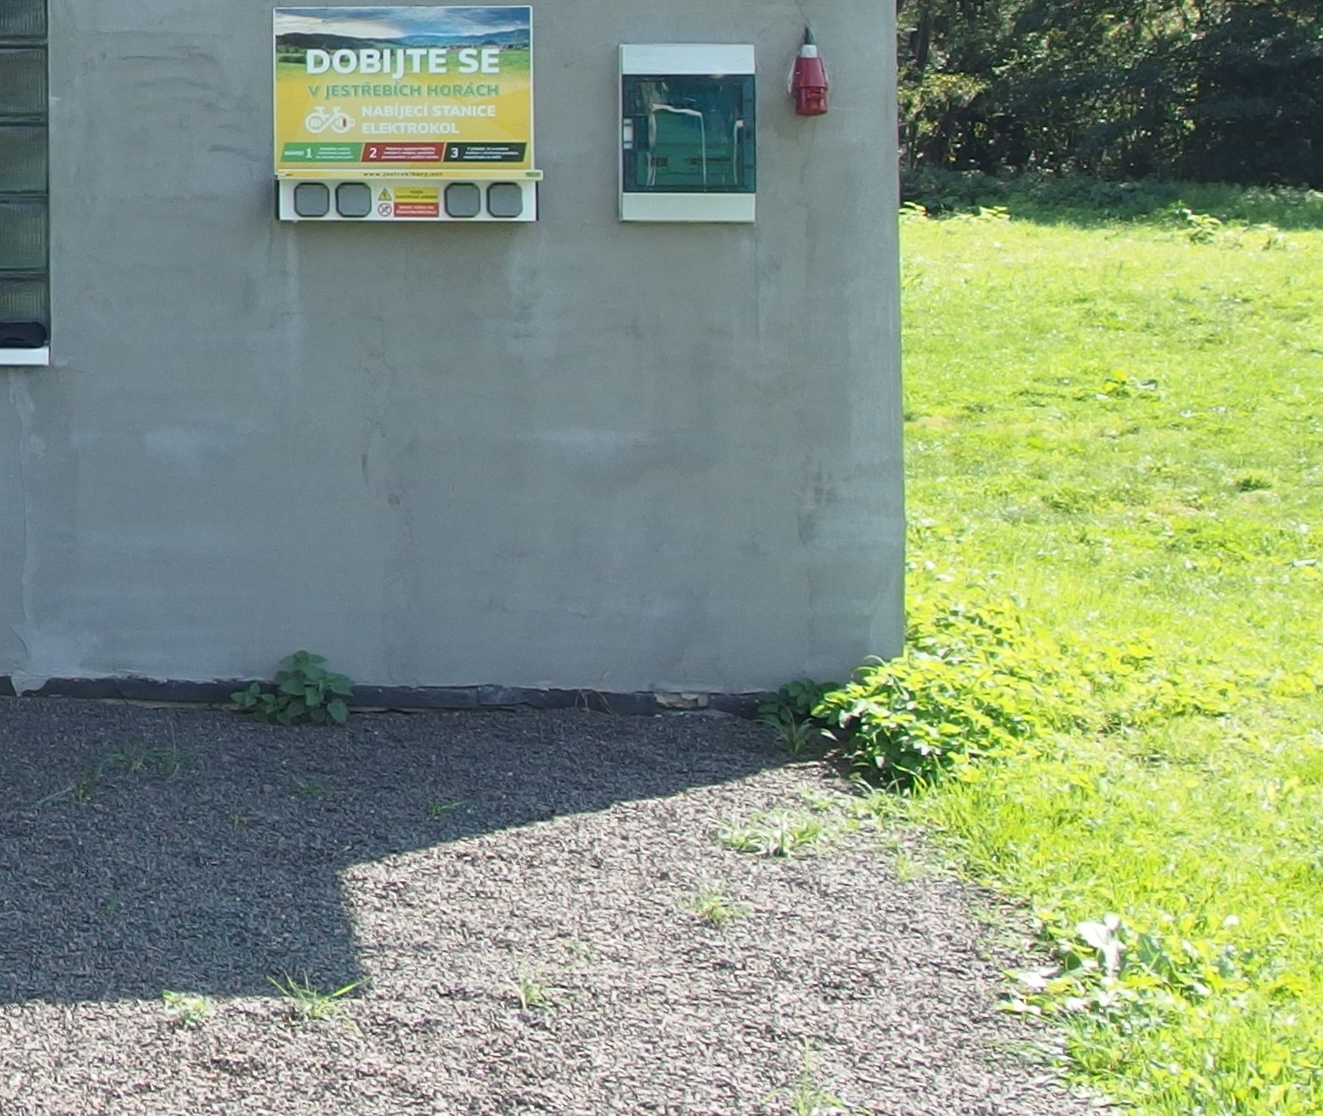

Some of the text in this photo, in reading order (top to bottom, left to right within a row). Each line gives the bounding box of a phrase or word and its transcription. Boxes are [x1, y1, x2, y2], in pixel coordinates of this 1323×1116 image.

[305, 48, 501, 80] DOBIJTE SE
[308, 82, 500, 100] V JESTŘEBÍCH HORÁCH
[361, 103, 497, 120] NABÍJECÍ STANICE
[361, 122, 460, 134] ELEKTROKOL
[305, 148, 313, 159] 1
[369, 147, 378, 159] 2
[450, 147, 459, 159] 3
